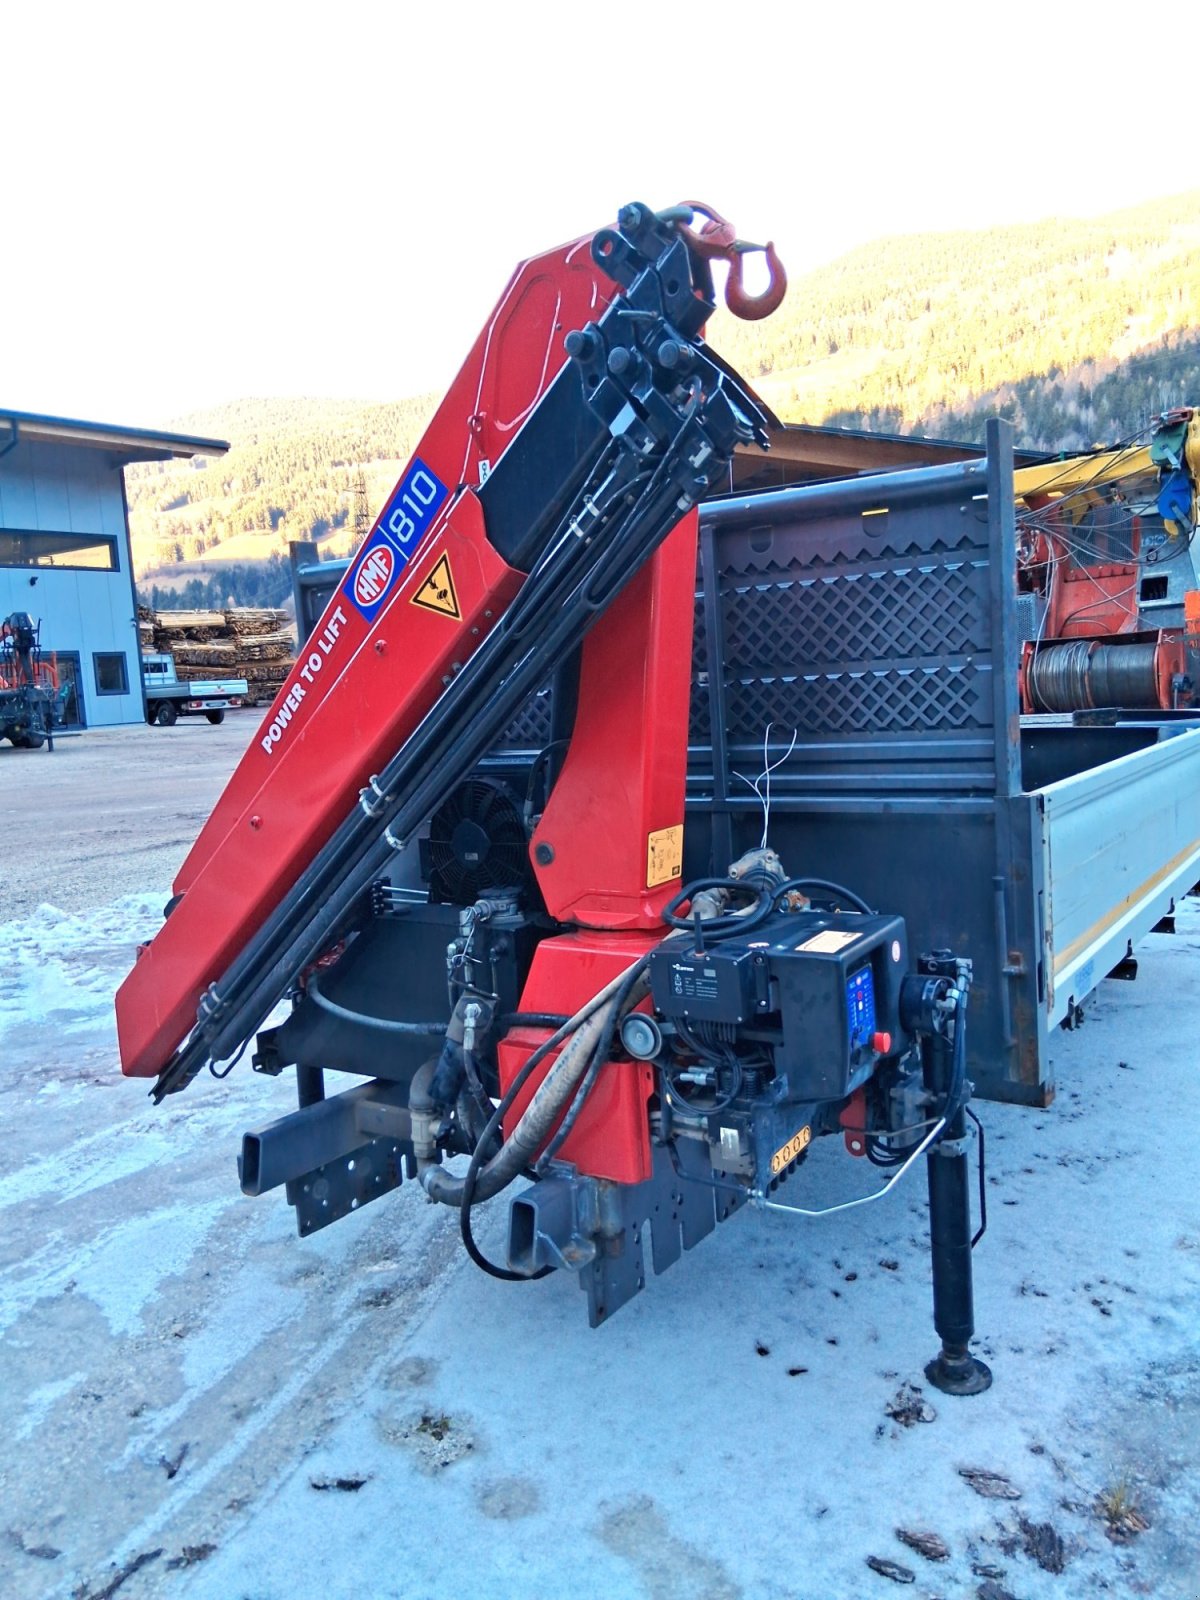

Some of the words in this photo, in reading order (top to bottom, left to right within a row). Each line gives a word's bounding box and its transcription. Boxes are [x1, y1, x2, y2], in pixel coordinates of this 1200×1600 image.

[357, 550, 390, 601] HMF
[389, 470, 437, 543] 810
[261, 682, 306, 755] POWER
[300, 653, 323, 683] TO
[317, 605, 348, 655] LIFT
